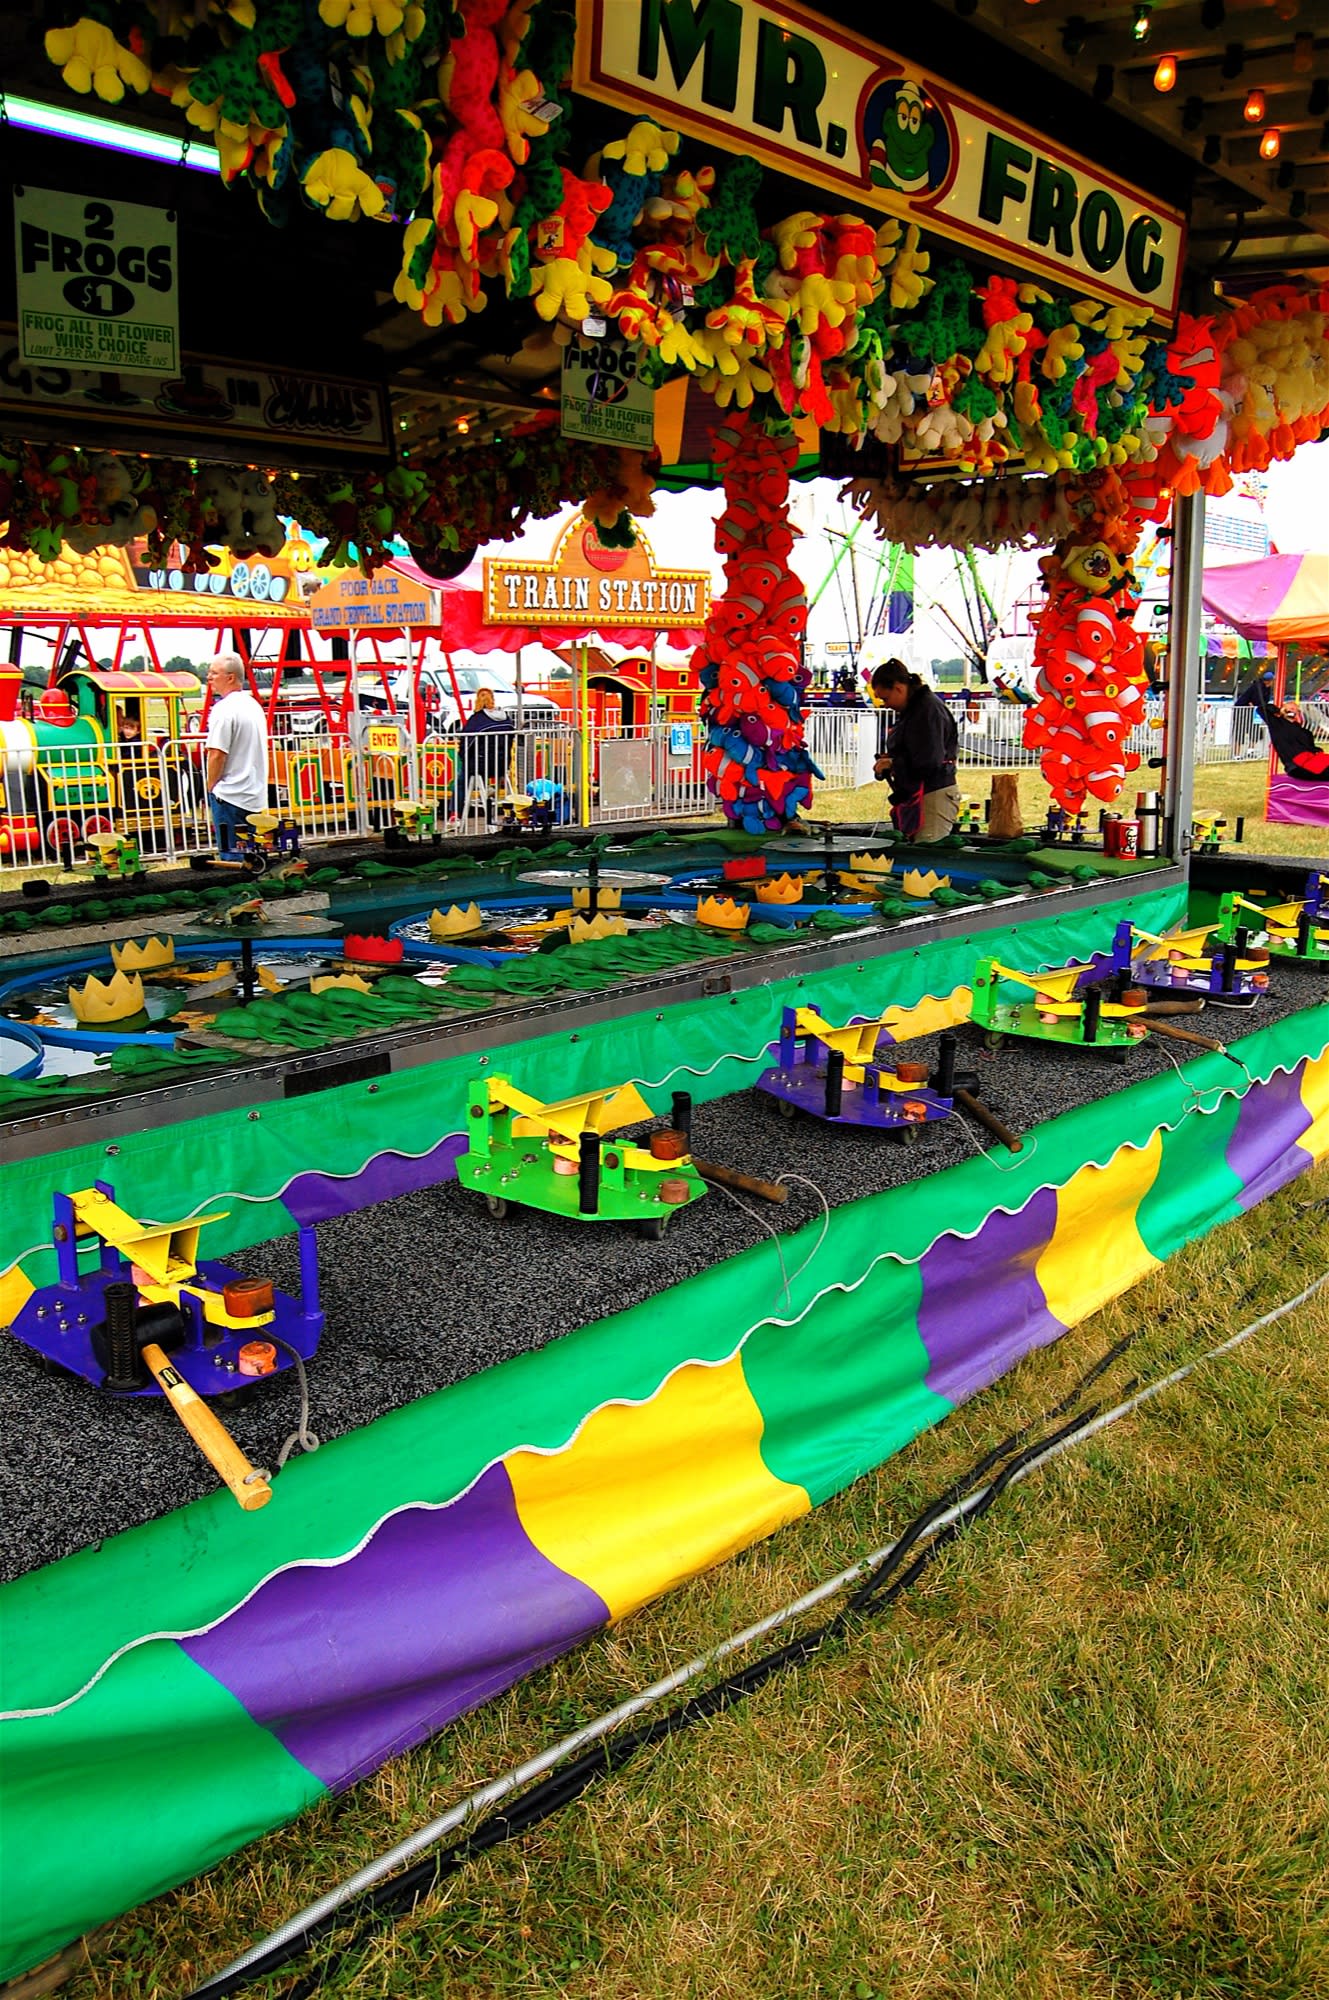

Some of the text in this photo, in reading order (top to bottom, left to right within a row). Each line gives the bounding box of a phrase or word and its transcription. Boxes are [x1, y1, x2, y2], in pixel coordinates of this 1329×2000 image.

[638, 0, 1163, 294] MR. FROG
[84, 202, 114, 241] 2
[20, 221, 172, 293] FROGS
[81, 282, 113, 312] $1
[25, 314, 171, 343] FROG ALL IN FLOWER
[31, 344, 54, 355] LIMIT
[56, 347, 63, 357] 2
[64, 348, 82, 359] PER
[84, 350, 102, 360] DAY
[109, 352, 122, 363] NO
[123, 353, 152, 365] TRADE
[153, 354, 169, 366] INS
[55, 333, 147, 355] WINS CHOICE
[564, 343, 637, 378] FROG
[227, 377, 260, 407] IN
[604, 418, 637, 433] CHOICE
[605, 407, 615, 418] IN
[617, 409, 652, 425] FLOWER
[340, 578, 399, 596] POOR JACK
[504, 574, 697, 613] TRAIN STATION
[386, 602, 426, 623] STATION
[372, 733, 397, 746] ENTER
